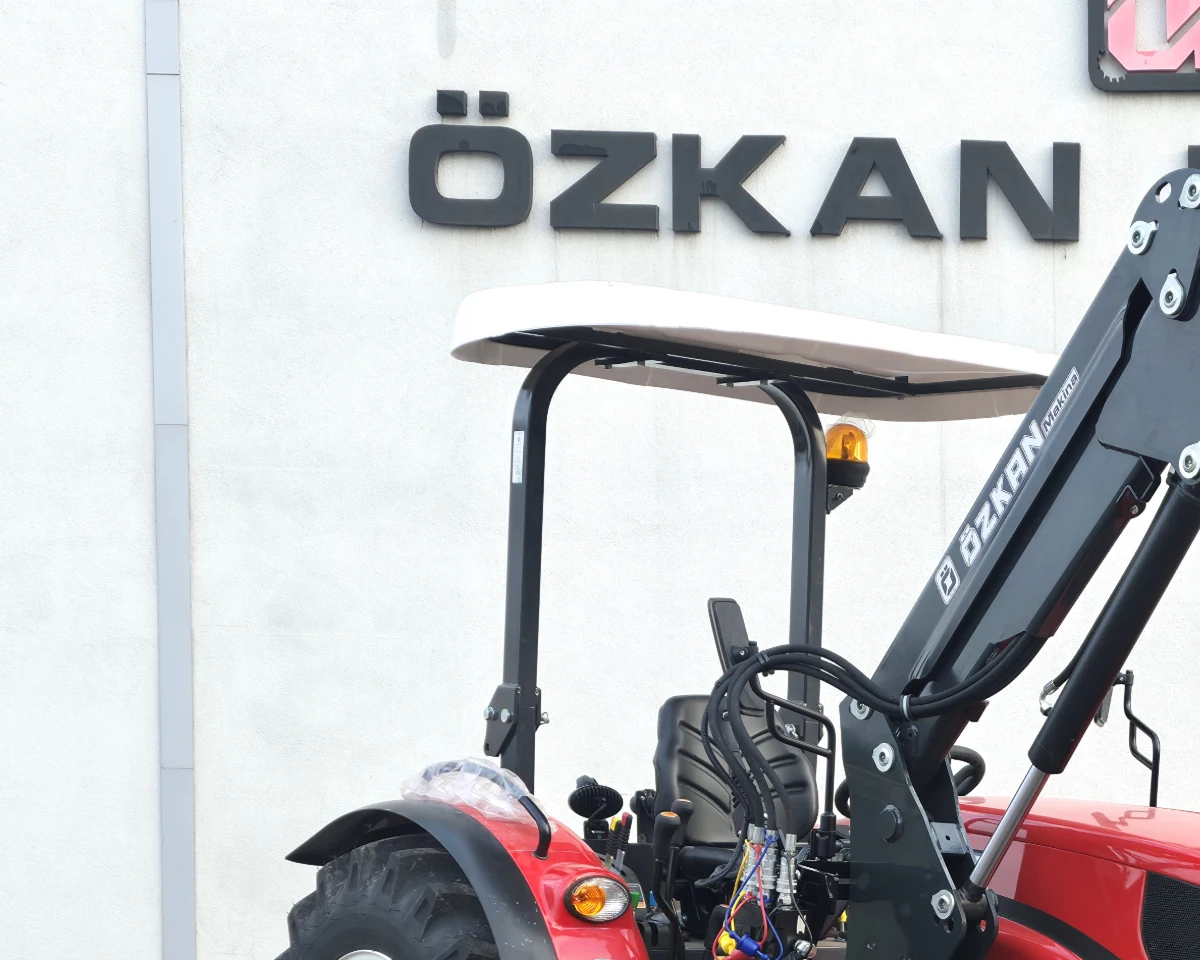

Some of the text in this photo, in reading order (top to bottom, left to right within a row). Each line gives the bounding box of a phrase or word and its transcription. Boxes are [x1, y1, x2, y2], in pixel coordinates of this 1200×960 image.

[408, 89, 1081, 242] ÖZKAN
[959, 419, 1045, 567] ÖZKAN
[1042, 373, 1080, 434] Makina
